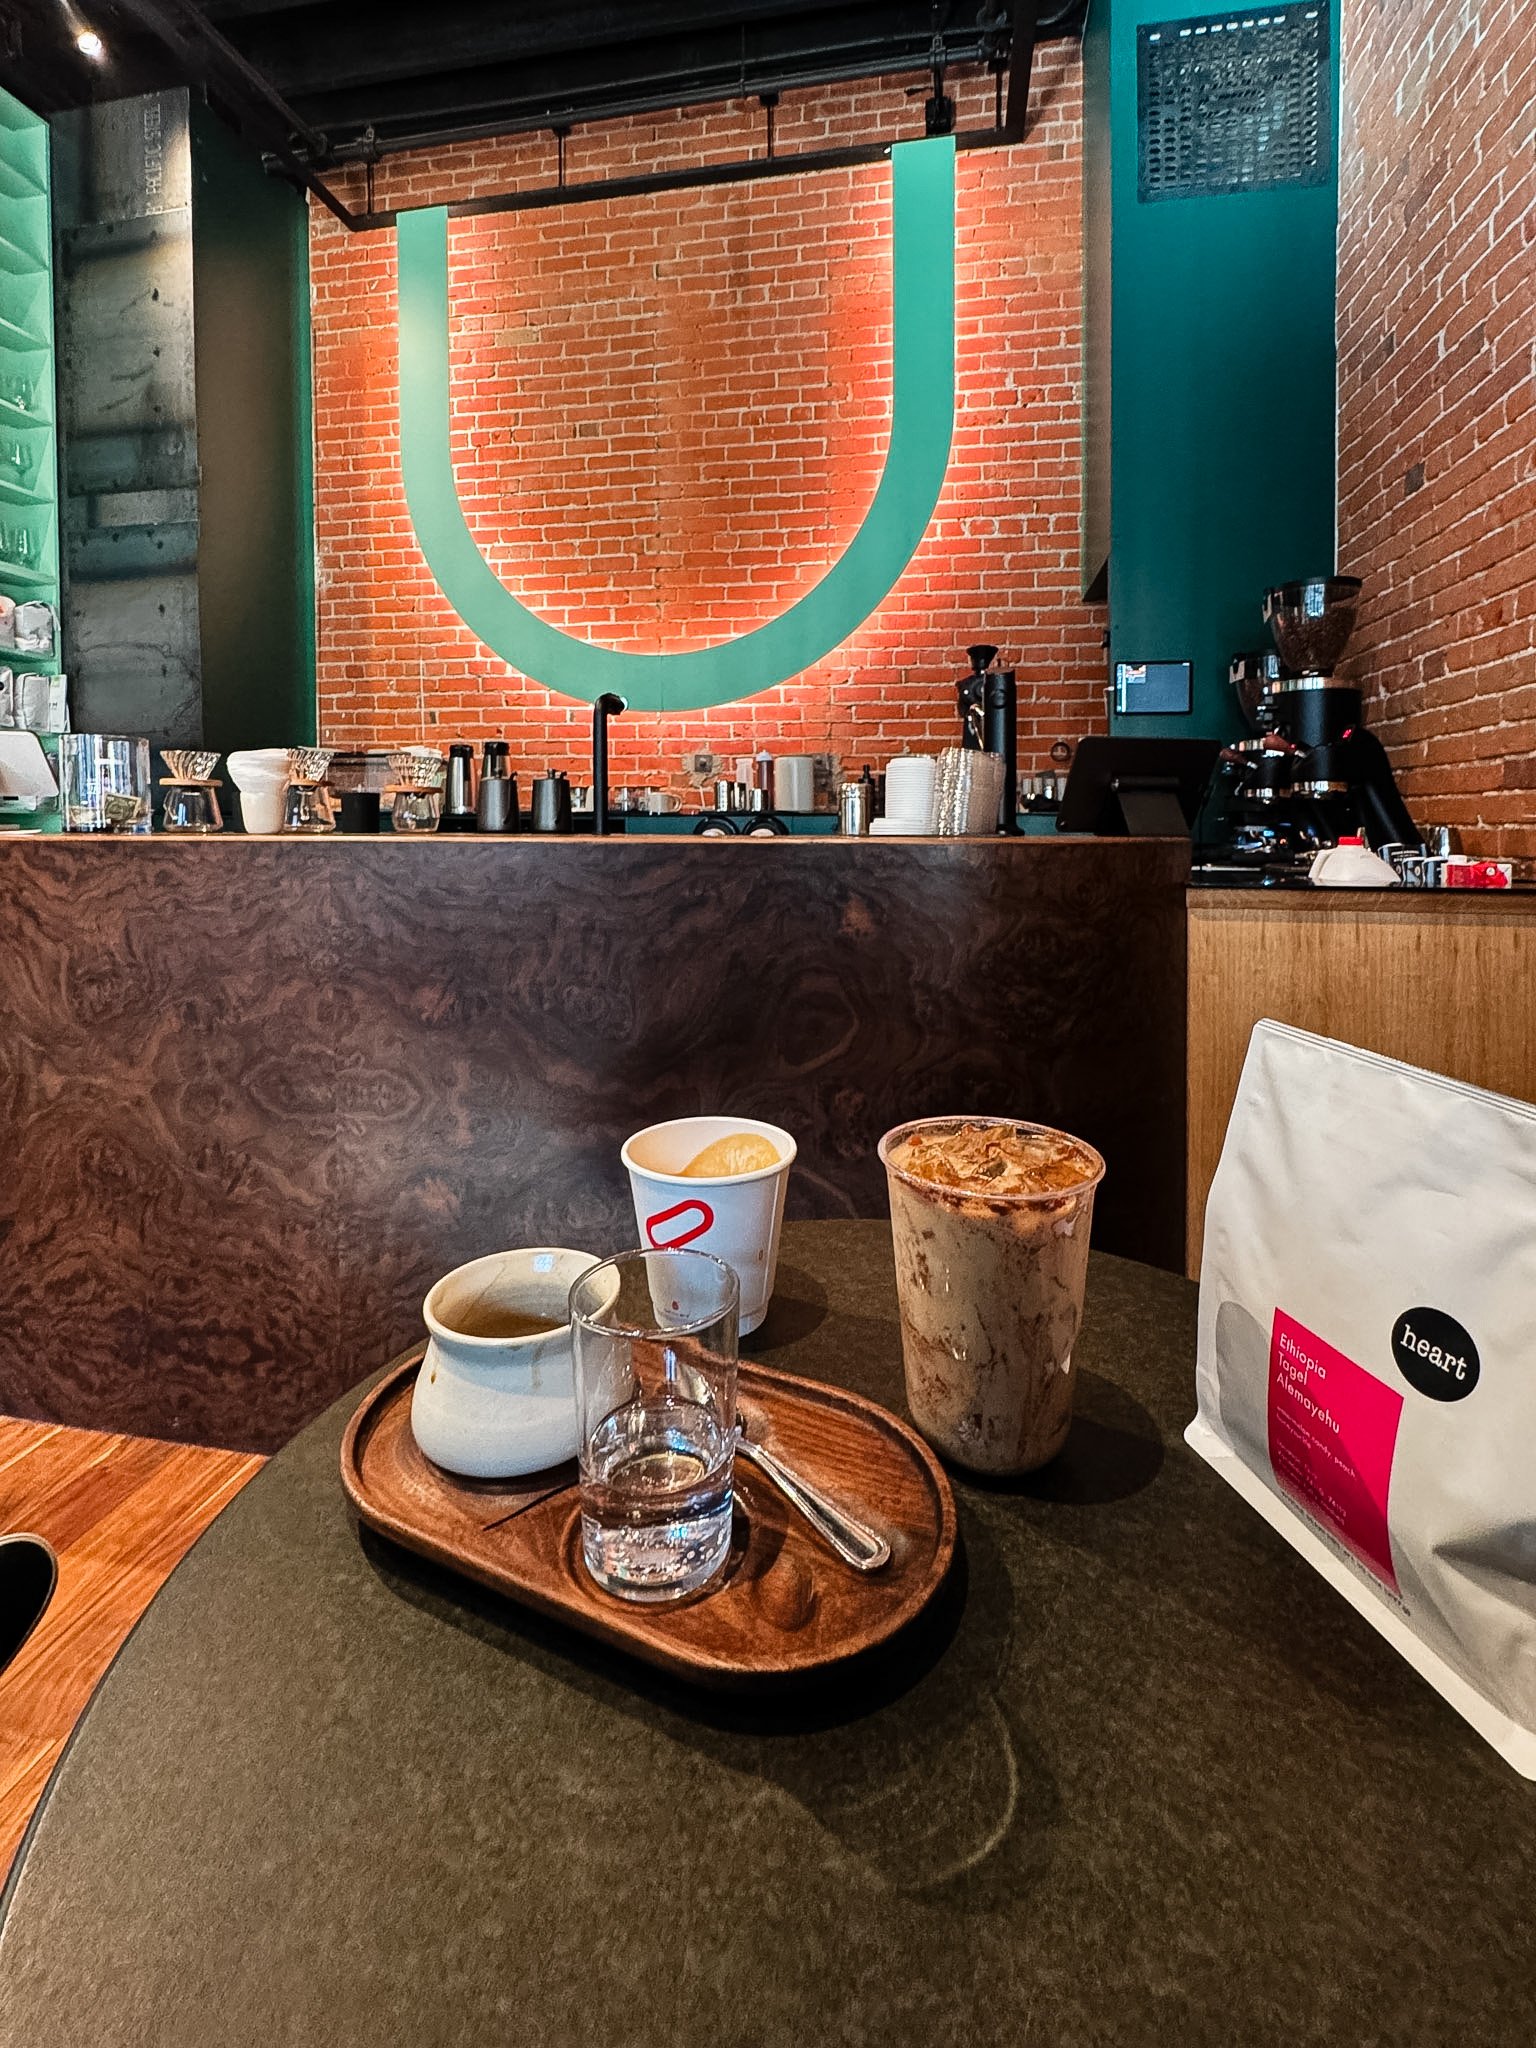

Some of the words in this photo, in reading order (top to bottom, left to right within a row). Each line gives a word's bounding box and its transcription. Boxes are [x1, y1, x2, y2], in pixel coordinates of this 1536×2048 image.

[144, 143, 162, 195] PACIFIC
[1278, 1350, 1308, 1386] Tagel
[1280, 1332, 1327, 1380] Ethiopia
[1400, 1323, 1467, 1381] heart
[1276, 1372, 1340, 1434] Alemayehu
